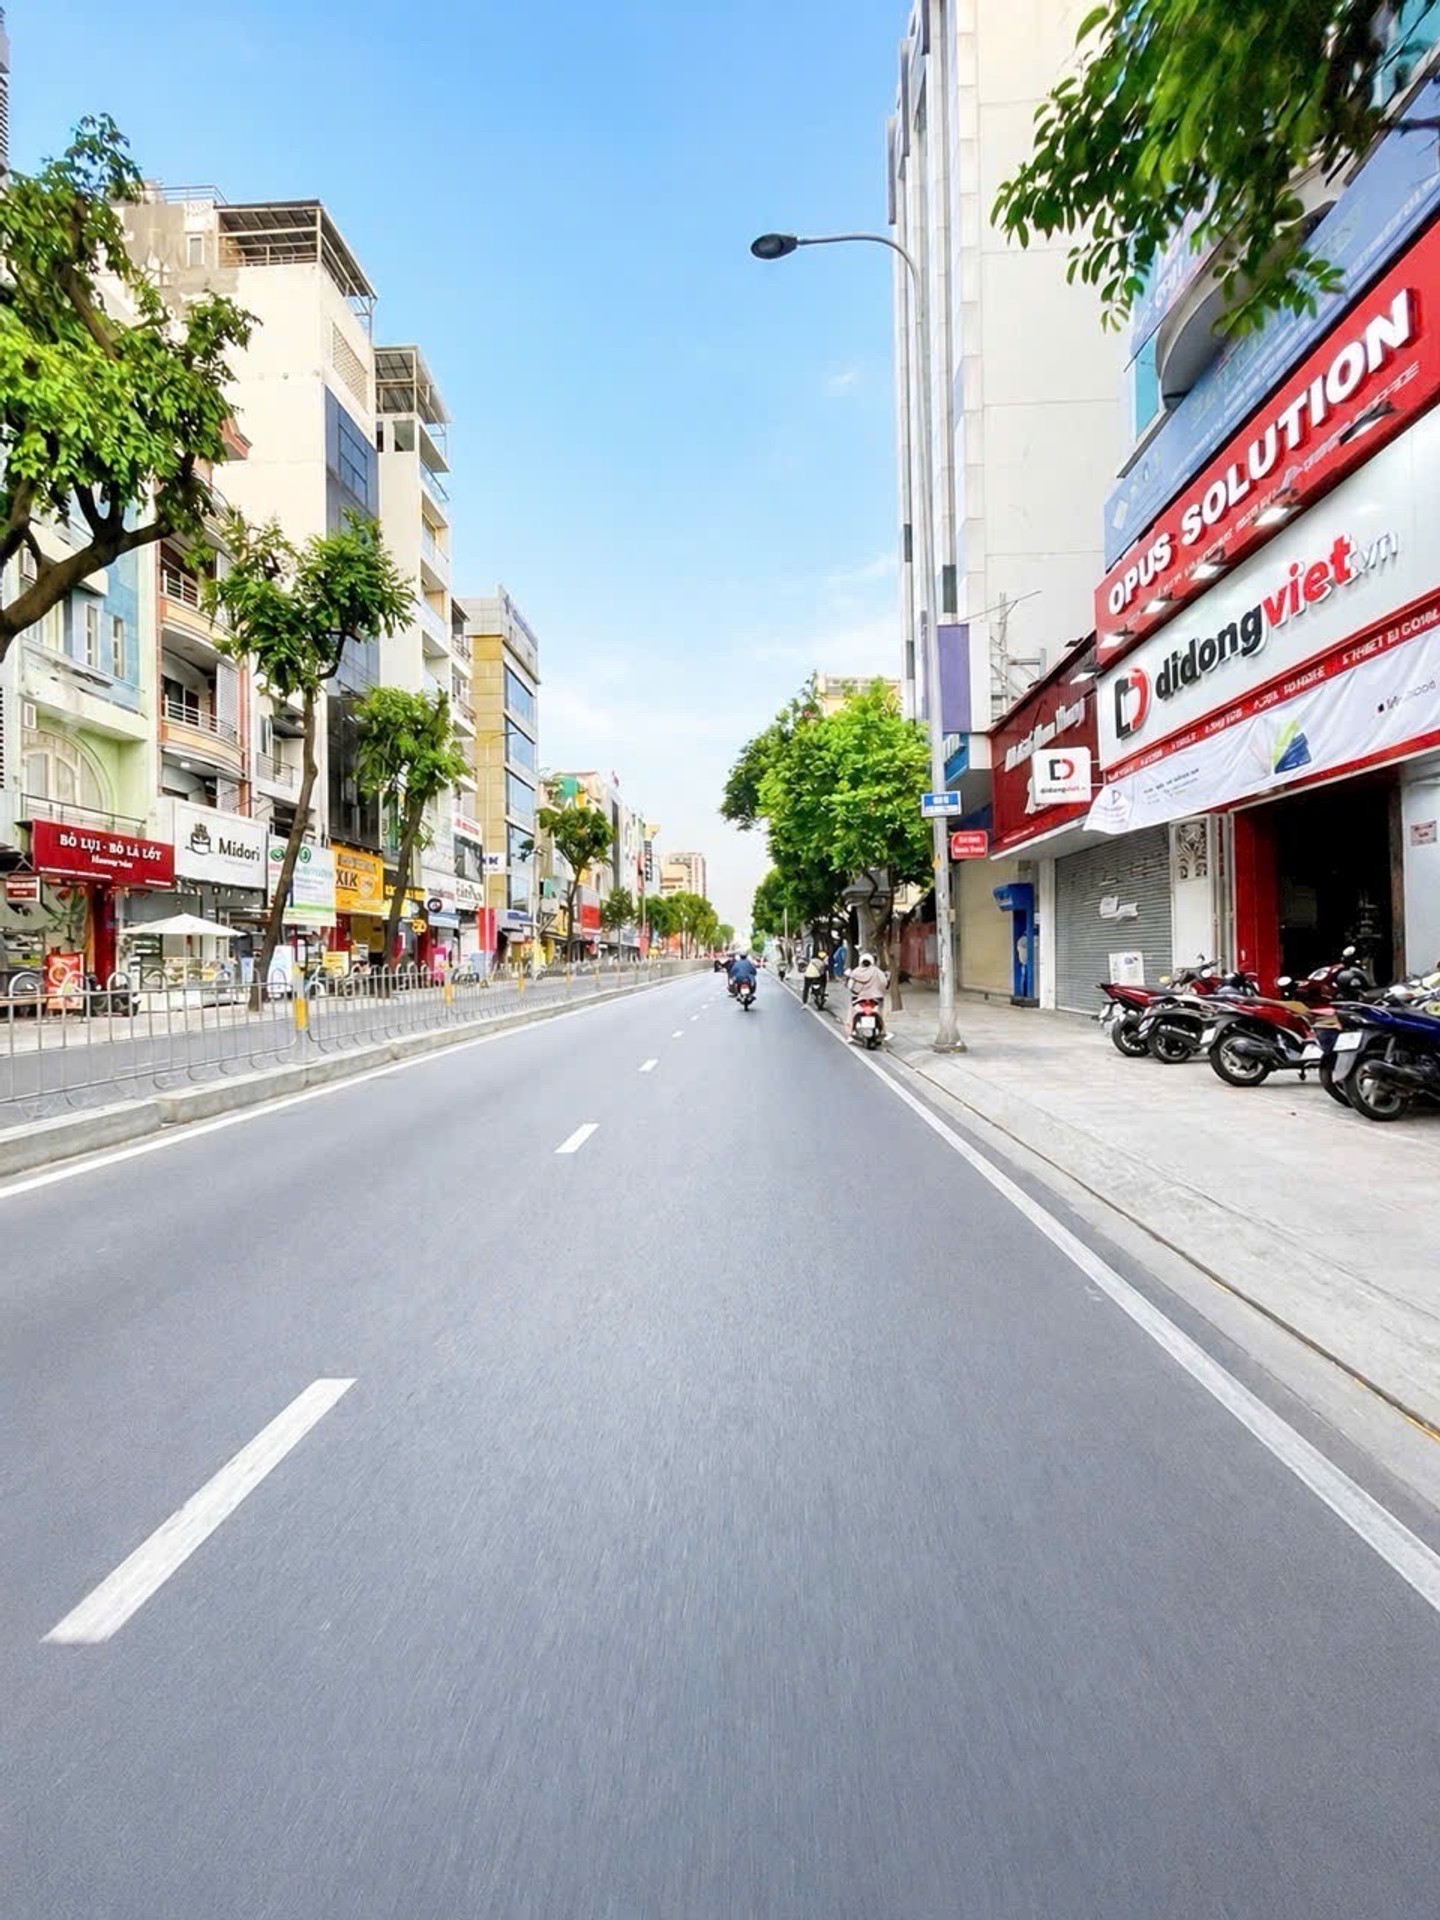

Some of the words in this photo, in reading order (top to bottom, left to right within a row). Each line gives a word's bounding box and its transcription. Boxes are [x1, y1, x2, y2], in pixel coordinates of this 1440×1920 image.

[1108, 532, 1172, 615] OPUS
[1181, 287, 1415, 545] SOLUTION
[218, 837, 261, 862] Midori
